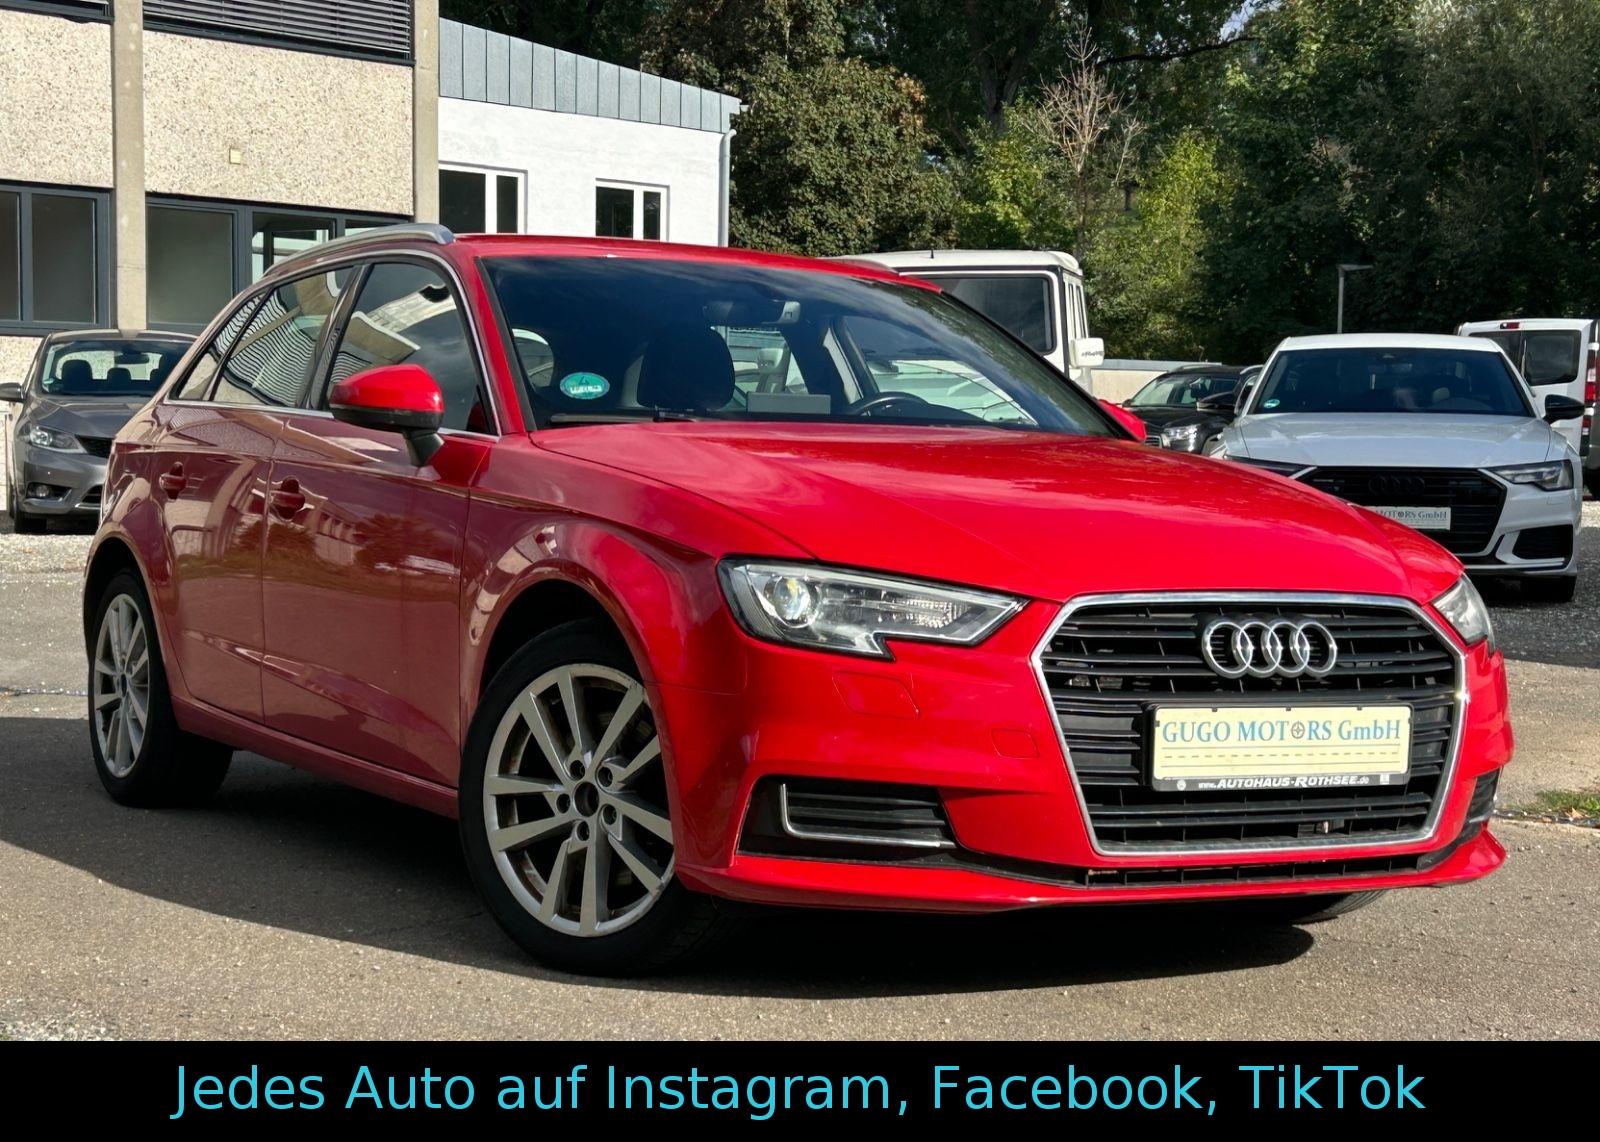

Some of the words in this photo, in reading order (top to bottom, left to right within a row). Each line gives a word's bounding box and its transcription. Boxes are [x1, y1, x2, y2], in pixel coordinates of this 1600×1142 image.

[1418, 511, 1448, 520] GmbH
[1162, 720, 1231, 743] GUGO
[1338, 719, 1400, 741] GmbH
